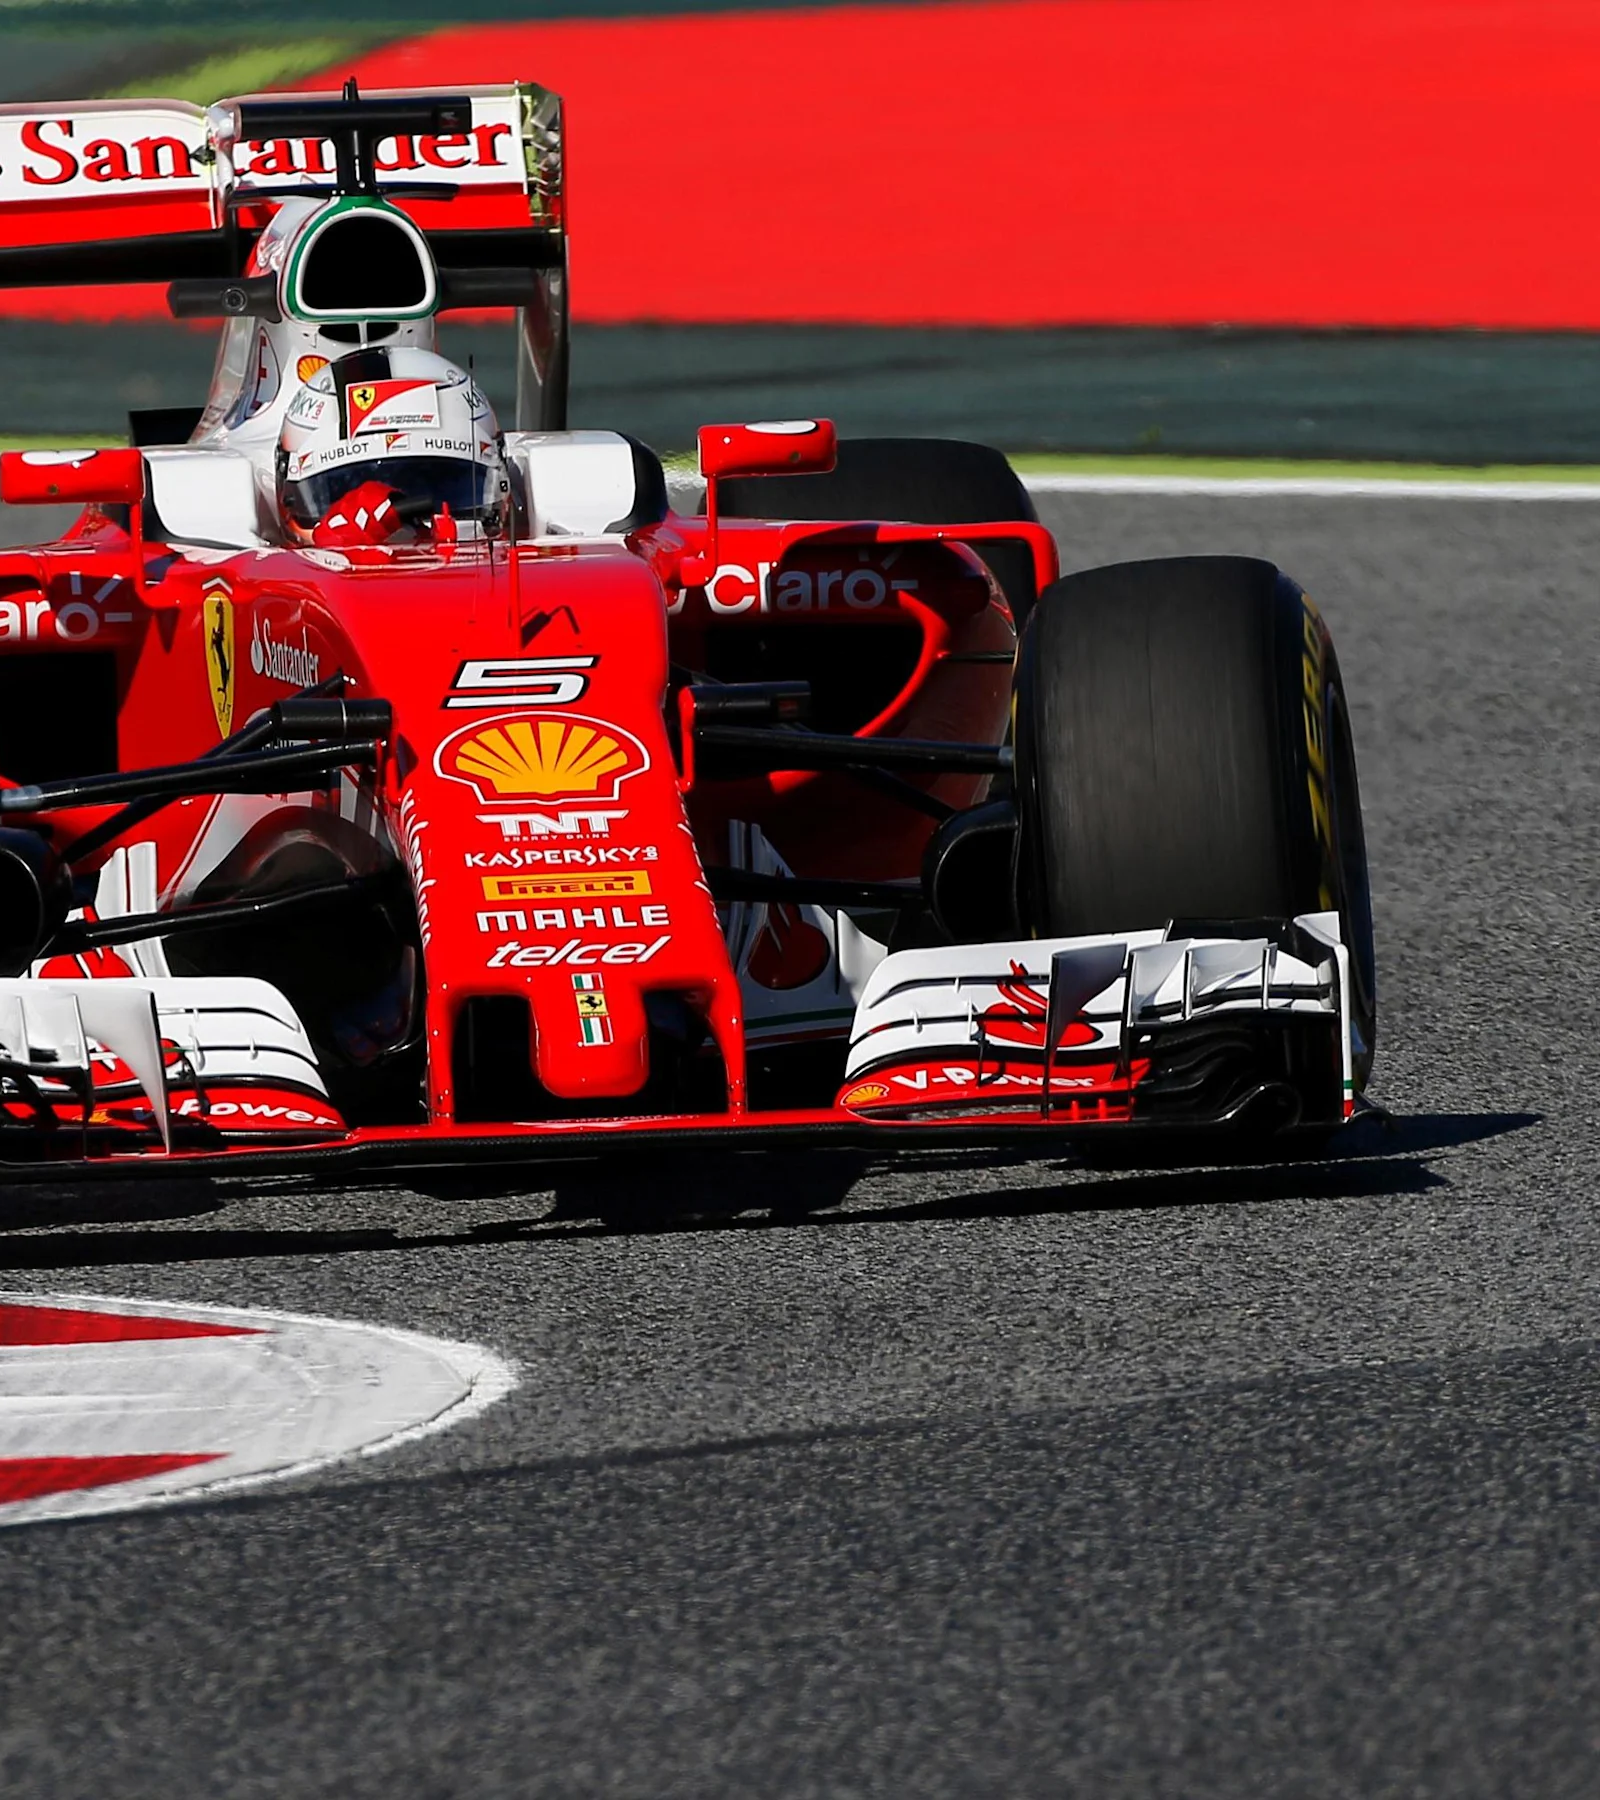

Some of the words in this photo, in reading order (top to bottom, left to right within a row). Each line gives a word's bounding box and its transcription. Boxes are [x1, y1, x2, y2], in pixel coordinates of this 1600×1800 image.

[320, 442, 369, 463] HUBLOT
[424, 438, 472, 452] HUBLOT
[263, 617, 319, 688] Santander
[440, 654, 601, 710] 5
[474, 809, 629, 836] TNT
[503, 834, 558, 843] ENERGY
[566, 832, 610, 841] DRINK
[465, 845, 641, 868] KASPERSKY
[497, 874, 635, 895] PIRELLI
[476, 904, 671, 934] MAHLE
[486, 935, 672, 968] telcel
